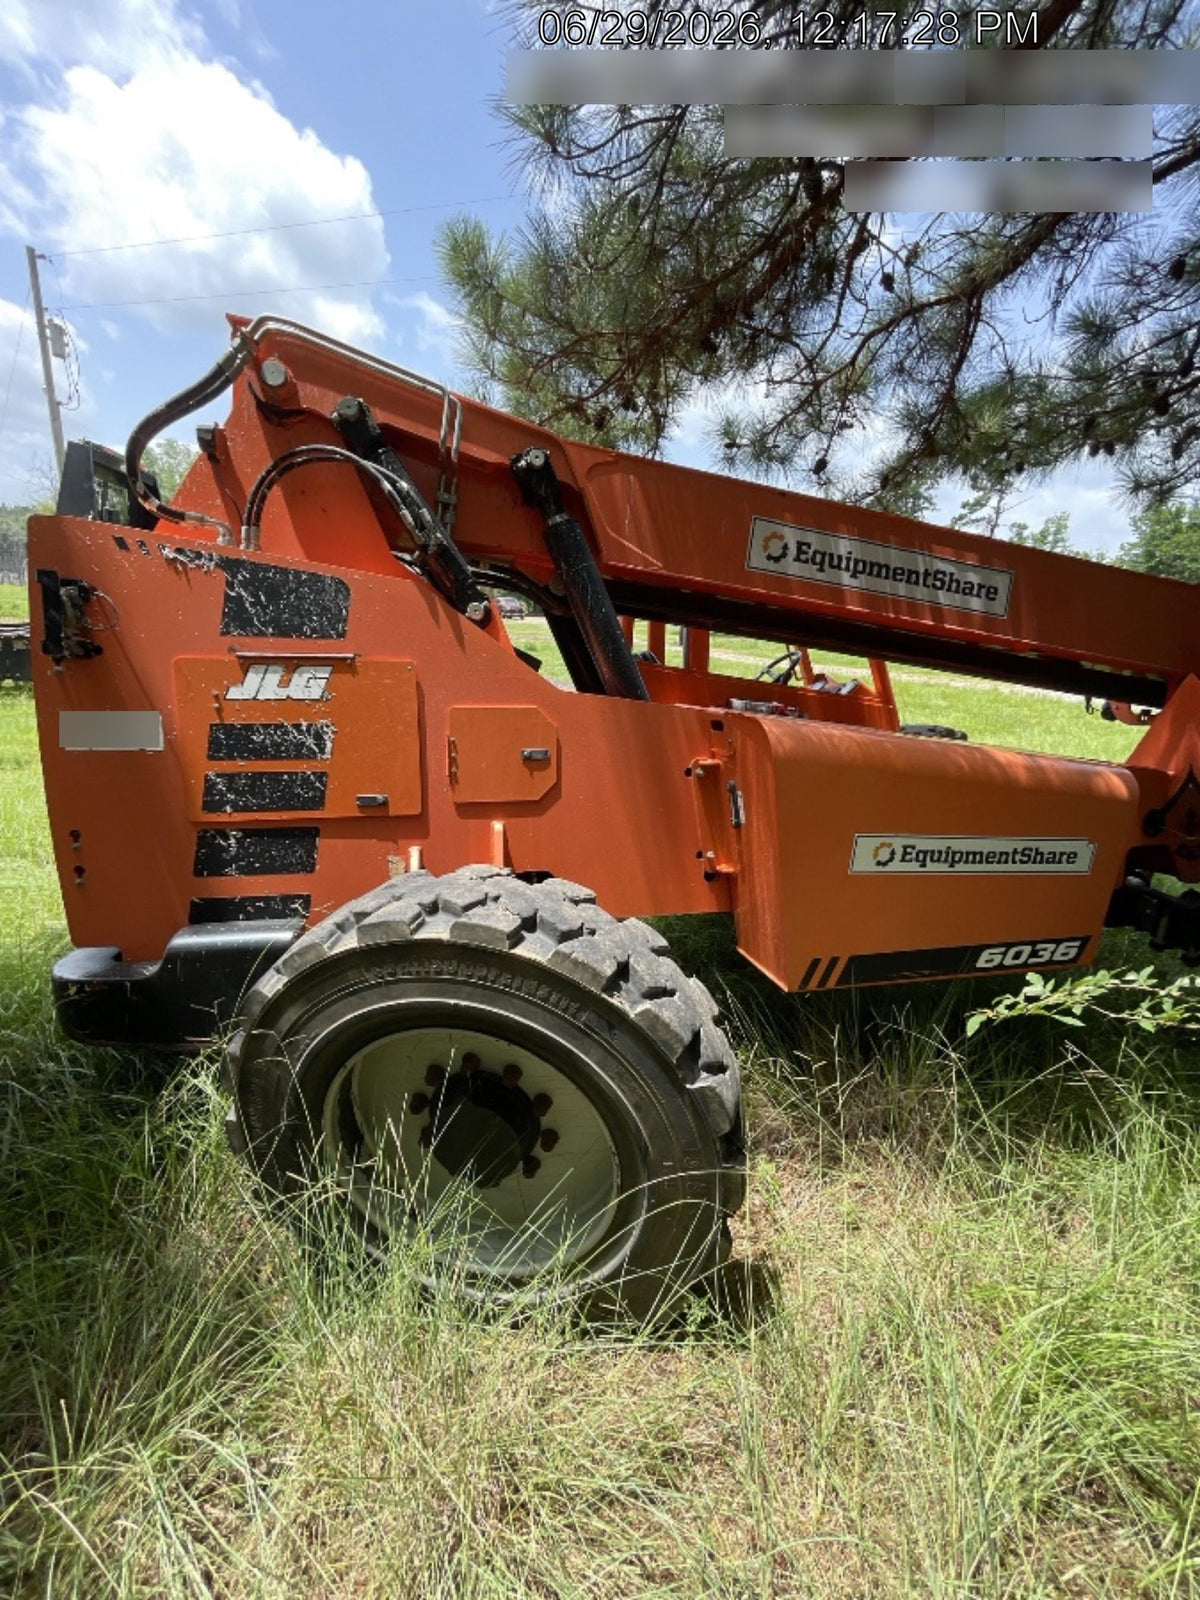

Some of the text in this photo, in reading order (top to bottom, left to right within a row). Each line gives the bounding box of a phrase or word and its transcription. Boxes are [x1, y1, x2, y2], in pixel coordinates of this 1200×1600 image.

[792, 540, 998, 602] EquipmentShare
[225, 663, 333, 700] JLG
[899, 844, 1078, 868] EquipmentShare
[975, 941, 1081, 969] 6036
